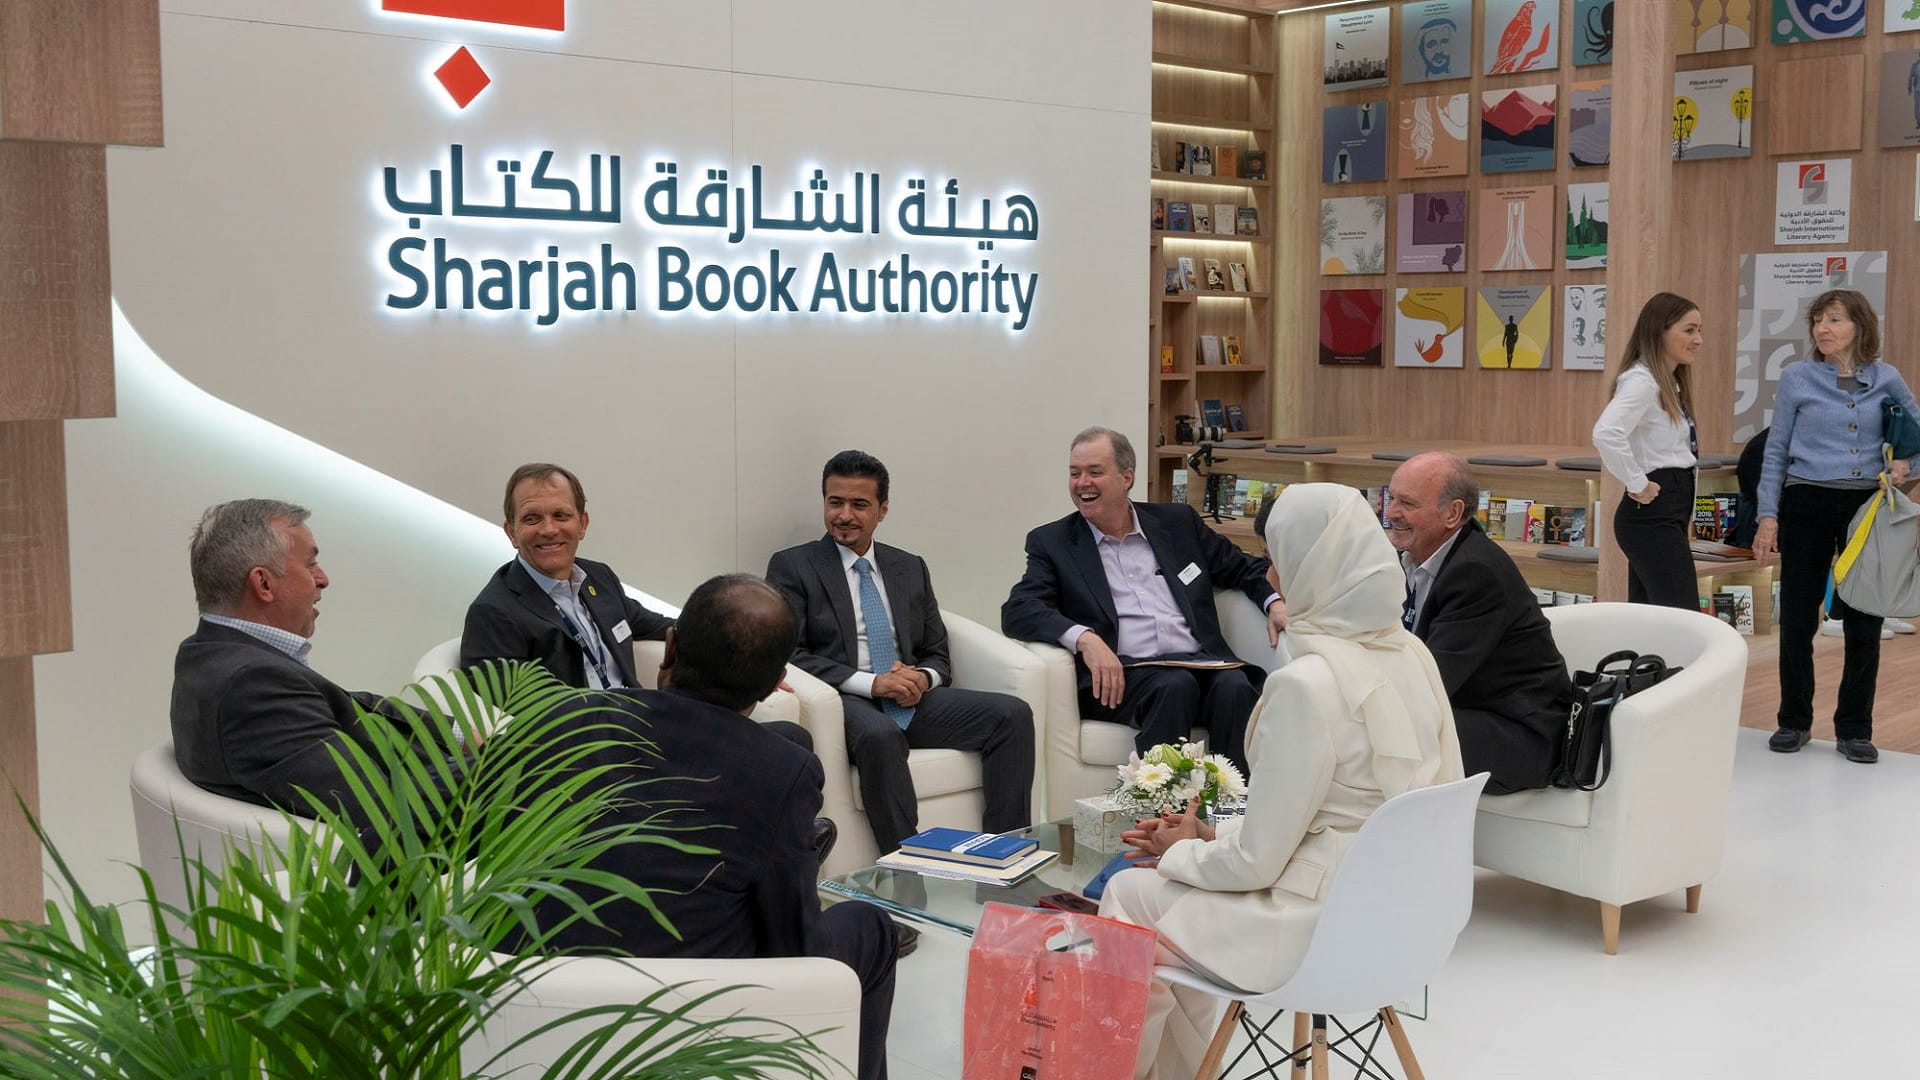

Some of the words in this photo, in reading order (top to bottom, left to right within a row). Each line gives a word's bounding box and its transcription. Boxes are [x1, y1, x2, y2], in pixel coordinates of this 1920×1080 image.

[384, 143, 621, 229] للكتاب
[644, 162, 880, 244] الشارقة
[898, 178, 1039, 251] هيئة
[1779, 210, 1802, 218] الدولية
[1803, 209, 1827, 218] الشارقة
[1779, 226, 1804, 234] Sharjah
[1804, 224, 1845, 232] International
[386, 236, 637, 326] Sharjah
[658, 246, 800, 312] Book
[809, 252, 1039, 331] Authority
